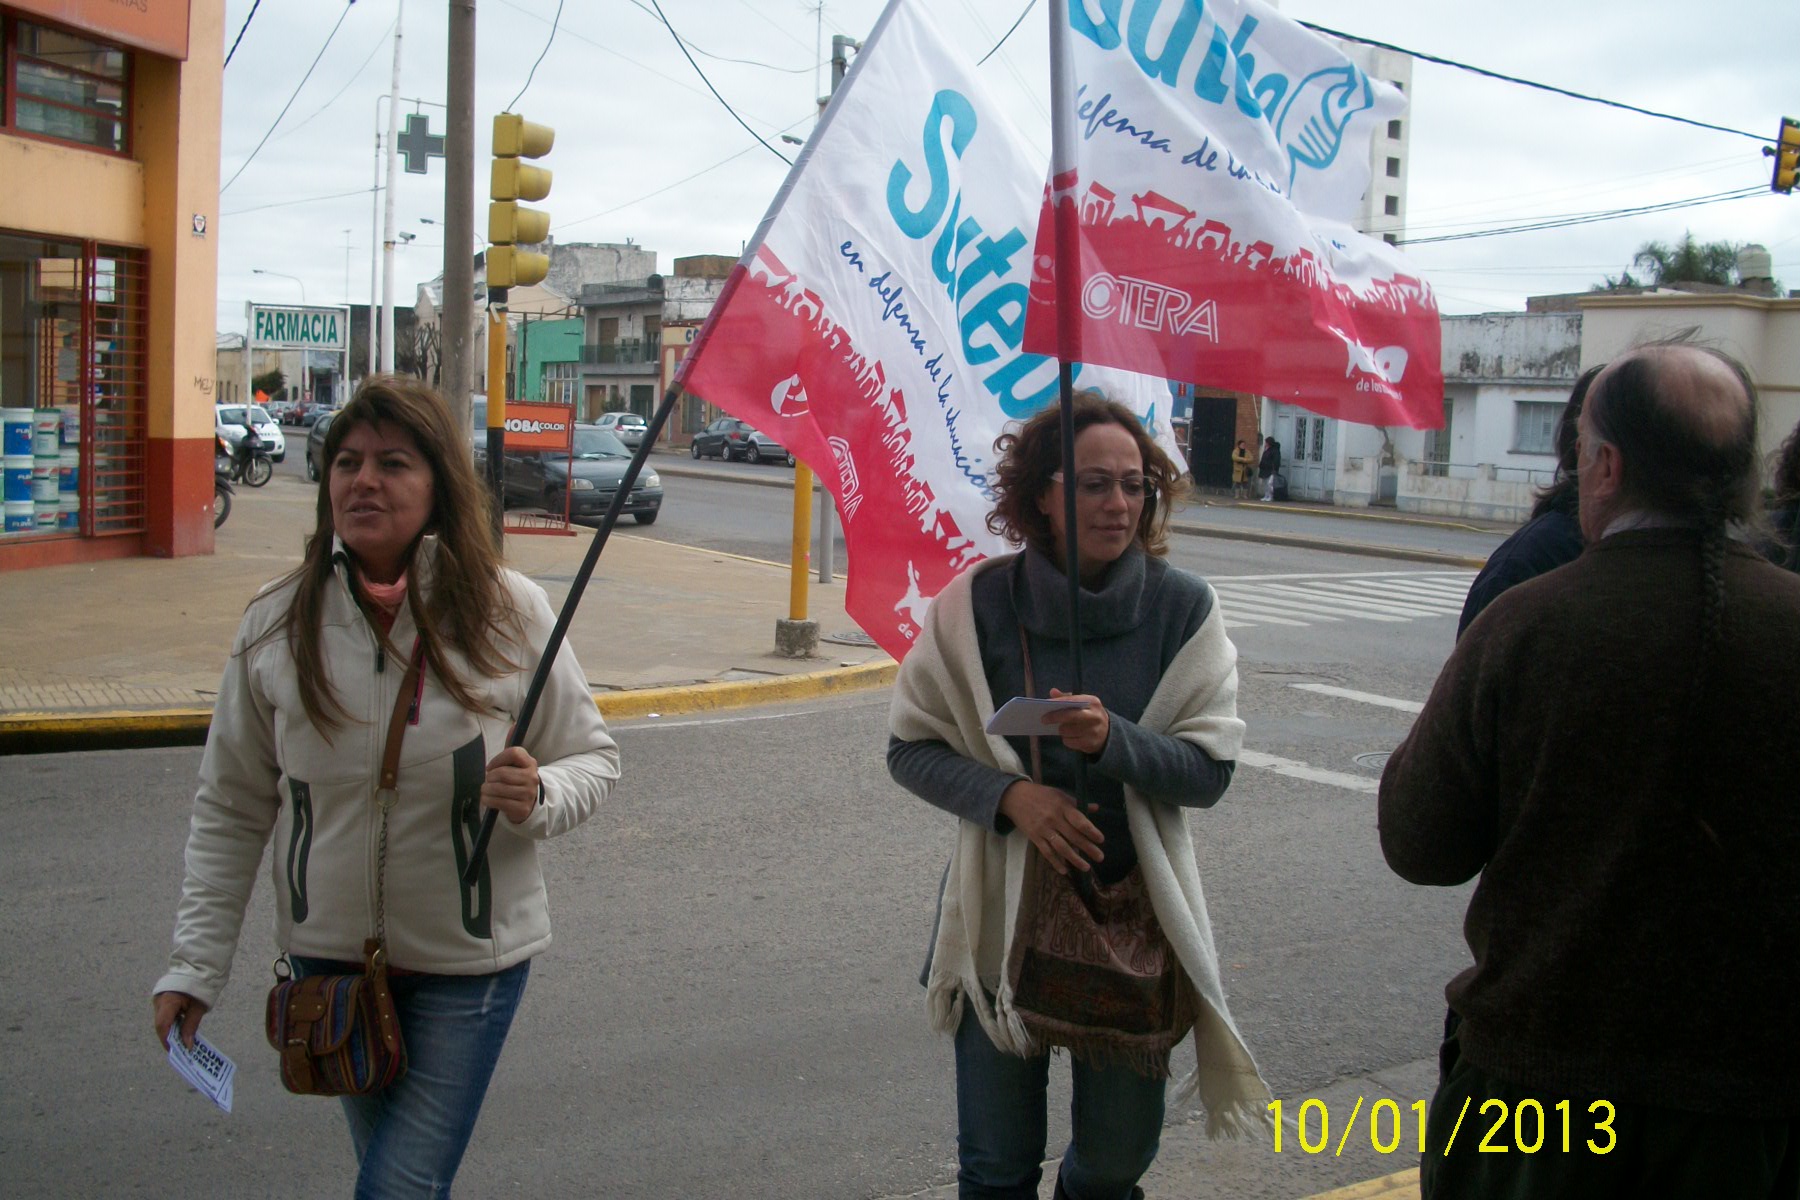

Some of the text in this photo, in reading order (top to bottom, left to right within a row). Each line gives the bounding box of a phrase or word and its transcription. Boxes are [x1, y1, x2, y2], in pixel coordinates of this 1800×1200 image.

[1181, 136, 1217, 171] de
[840, 240, 863, 272] en
[868, 271, 926, 355] defensa
[924, 352, 943, 382] de
[937, 373, 952, 408] la
[1081, 272, 1219, 343] CTERA
[256, 311, 338, 343] FARMACIA
[898, 623, 914, 640] de
